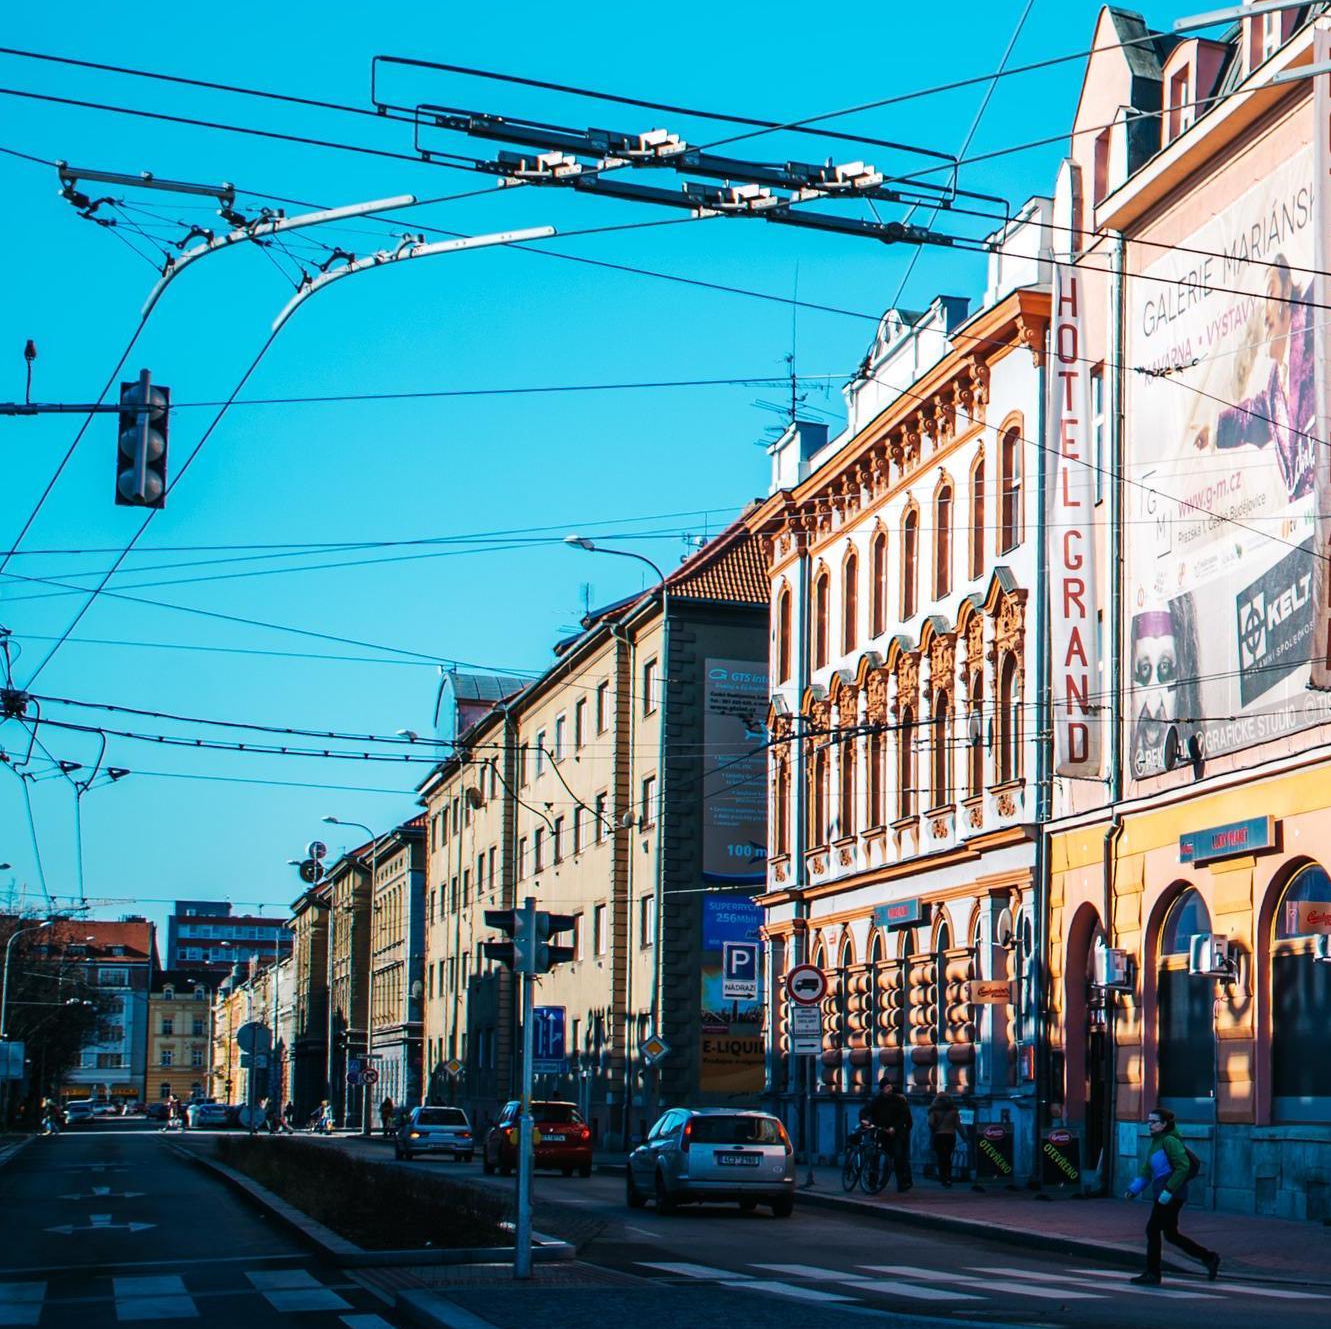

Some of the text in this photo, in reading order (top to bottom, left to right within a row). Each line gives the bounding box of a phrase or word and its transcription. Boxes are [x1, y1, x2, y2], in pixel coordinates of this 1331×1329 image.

[1142, 256, 1214, 338] GALERIE
[1178, 470, 1241, 519] www.g-m.cz
[1057, 276, 1088, 765] HOTEL GRAND
[1266, 571, 1312, 631] KELT
[731, 672, 752, 682] GTS
[1257, 704, 1296, 735] STUDIO
[1146, 738, 1190, 767] REKA
[727, 844, 752, 857] 100
[732, 949, 750, 974] P
[980, 1140, 1012, 1175] OTEVŘENO
[1043, 1143, 1079, 1181] OTEVŘENO
